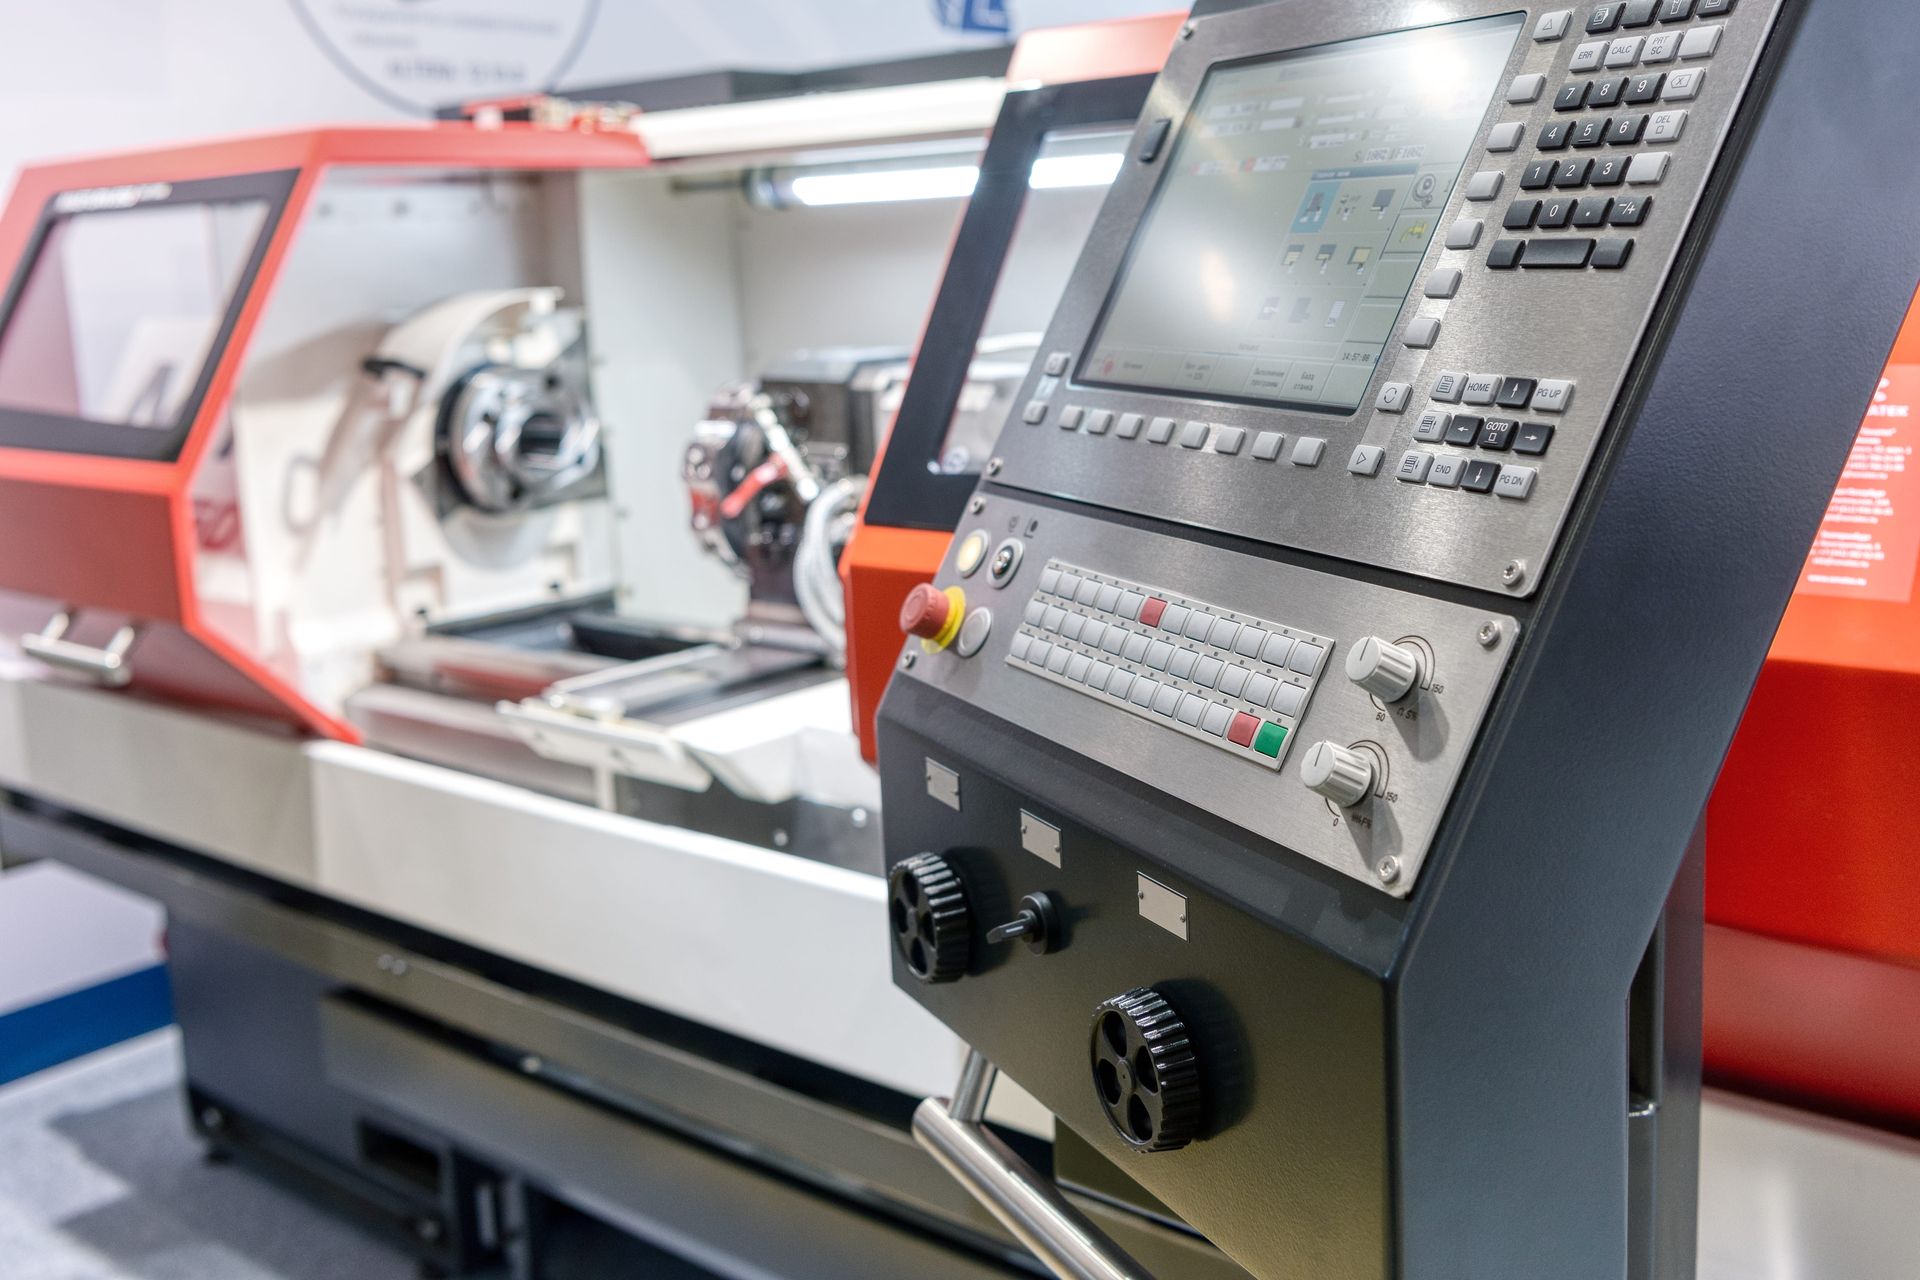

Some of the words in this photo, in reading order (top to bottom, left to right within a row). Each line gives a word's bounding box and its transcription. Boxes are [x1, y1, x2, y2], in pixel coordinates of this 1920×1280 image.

[1652, 36, 1669, 44] PRT
[1578, 50, 1593, 60] ERR
[1611, 45, 1632, 55] CALC
[1650, 46, 1662, 55] SC
[1567, 87, 1575, 100] 7
[1601, 84, 1609, 96] 8
[1637, 80, 1647, 92] 9
[1655, 115, 1671, 124] DEL
[1548, 127, 1556, 140] 4
[1583, 124, 1593, 136] 5
[1619, 121, 1629, 133] 6
[1533, 166, 1541, 179] 1
[1566, 164, 1576, 177] 2
[1603, 162, 1612, 175] 3
[1549, 205, 1559, 217] 0
[1467, 383, 1490, 392] HOME
[1537, 389, 1548, 397] PG
[1549, 390, 1562, 398] UP
[1485, 421, 1508, 432] GOTO
[1435, 465, 1451, 474] END
[1500, 474, 1511, 484] PG
[1512, 477, 1523, 486] DN
[1431, 683, 1444, 694] 150
[1386, 792, 1398, 803] 150
[1333, 818, 1339, 827] 0
